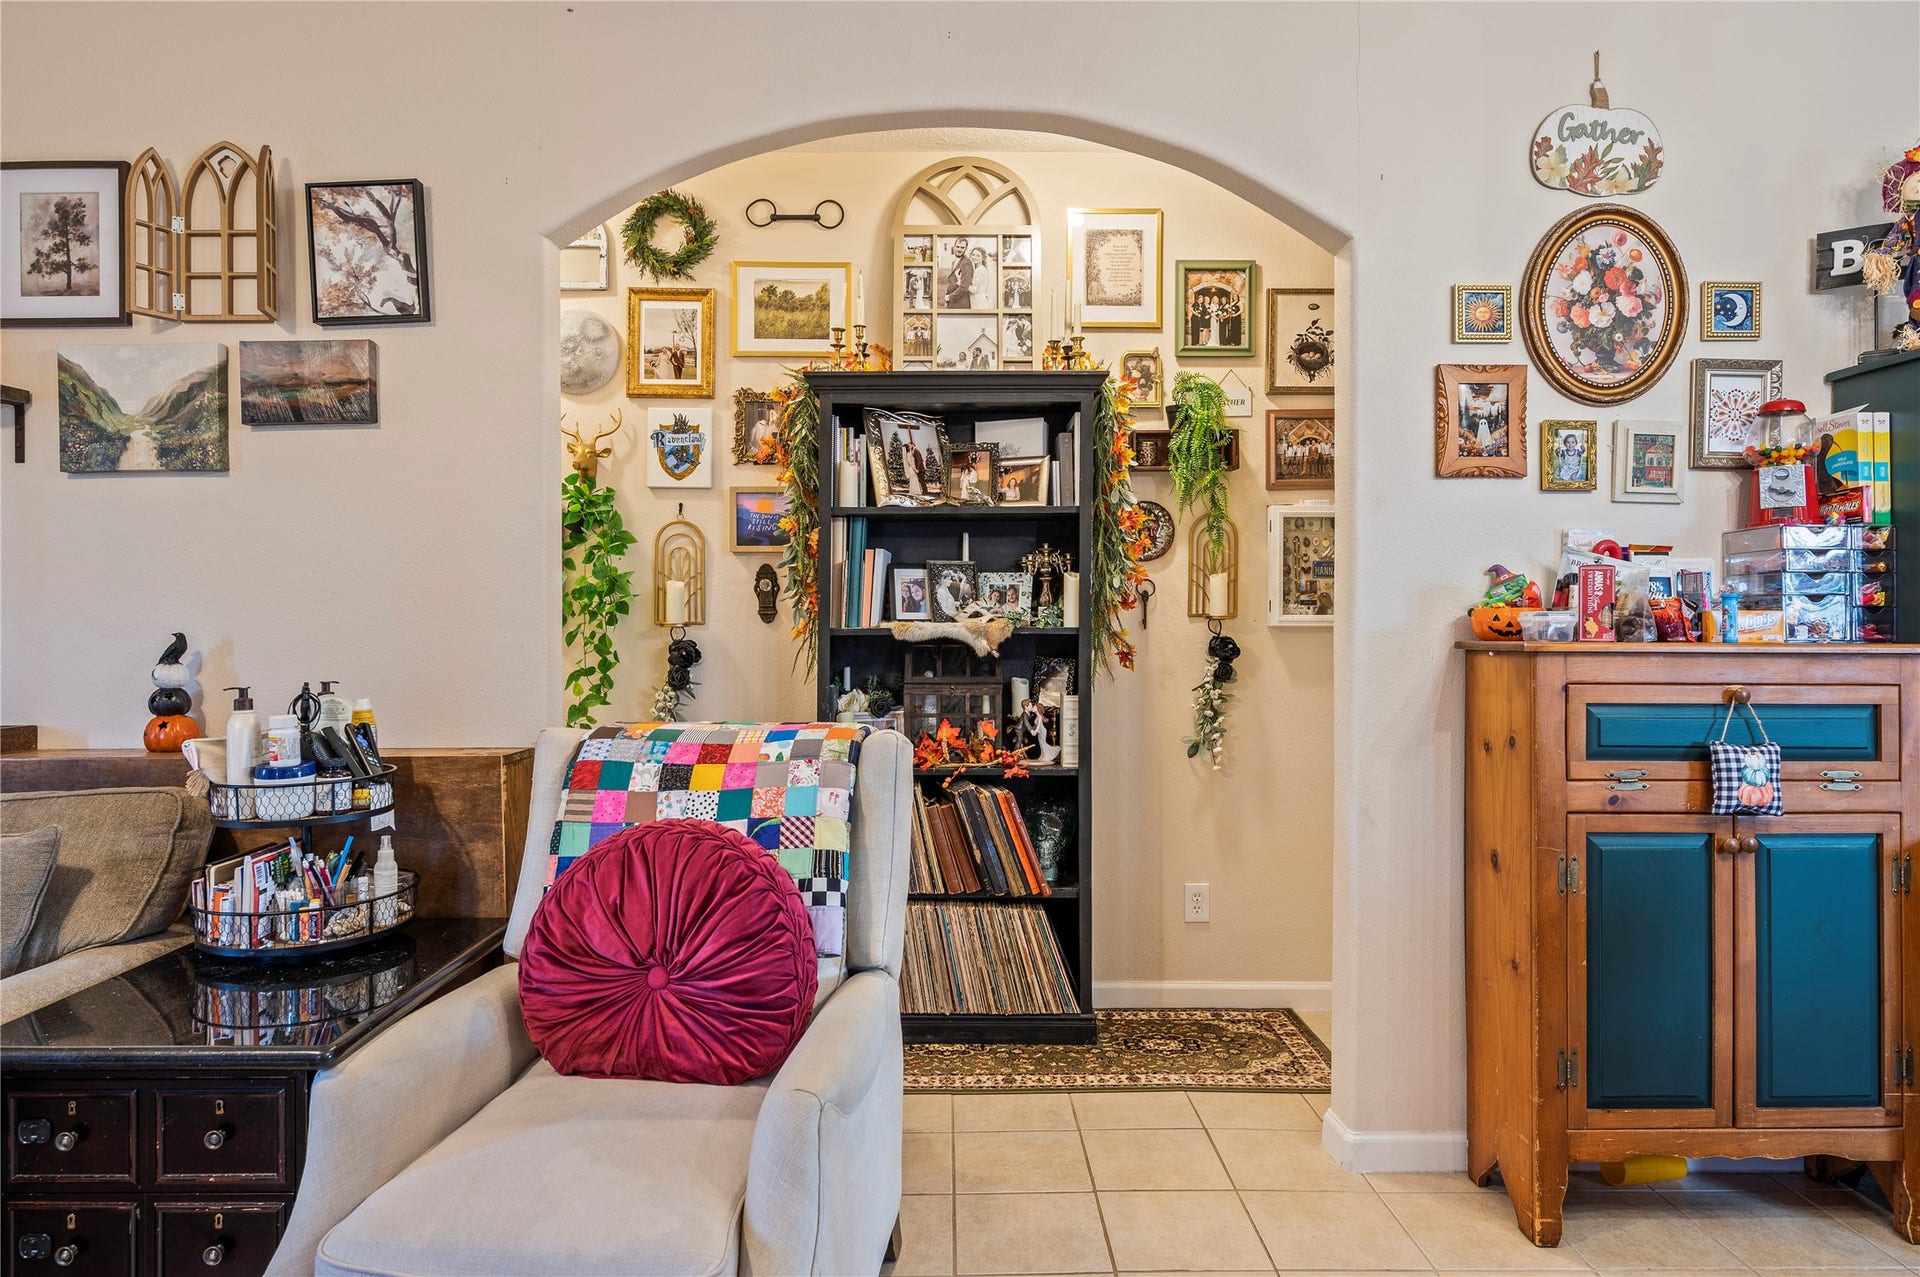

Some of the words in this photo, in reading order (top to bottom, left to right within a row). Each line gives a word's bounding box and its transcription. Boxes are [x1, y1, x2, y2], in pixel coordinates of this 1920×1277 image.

[1557, 111, 1645, 146] Gather
[1828, 418, 1851, 432] Stover
[747, 523, 777, 532] RISING
[1747, 612, 1776, 629] Duds
